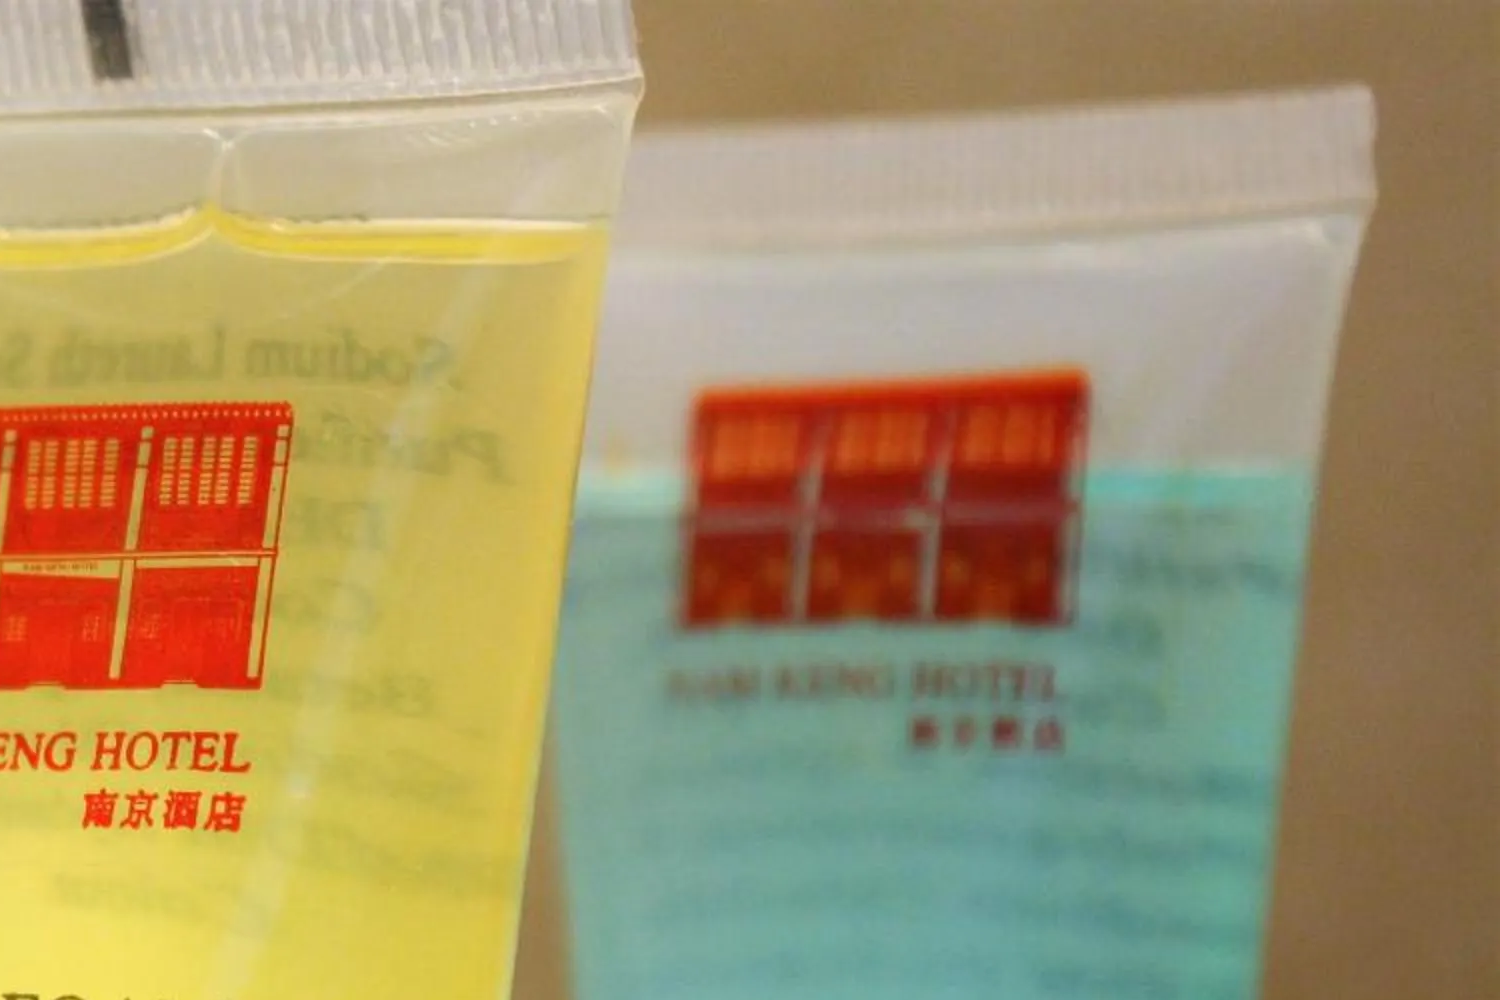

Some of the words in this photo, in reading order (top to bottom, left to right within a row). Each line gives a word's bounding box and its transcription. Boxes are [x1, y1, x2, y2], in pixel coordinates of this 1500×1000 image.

[90, 731, 251, 773] HOTEL
[81, 788, 247, 833] 南京酒店
